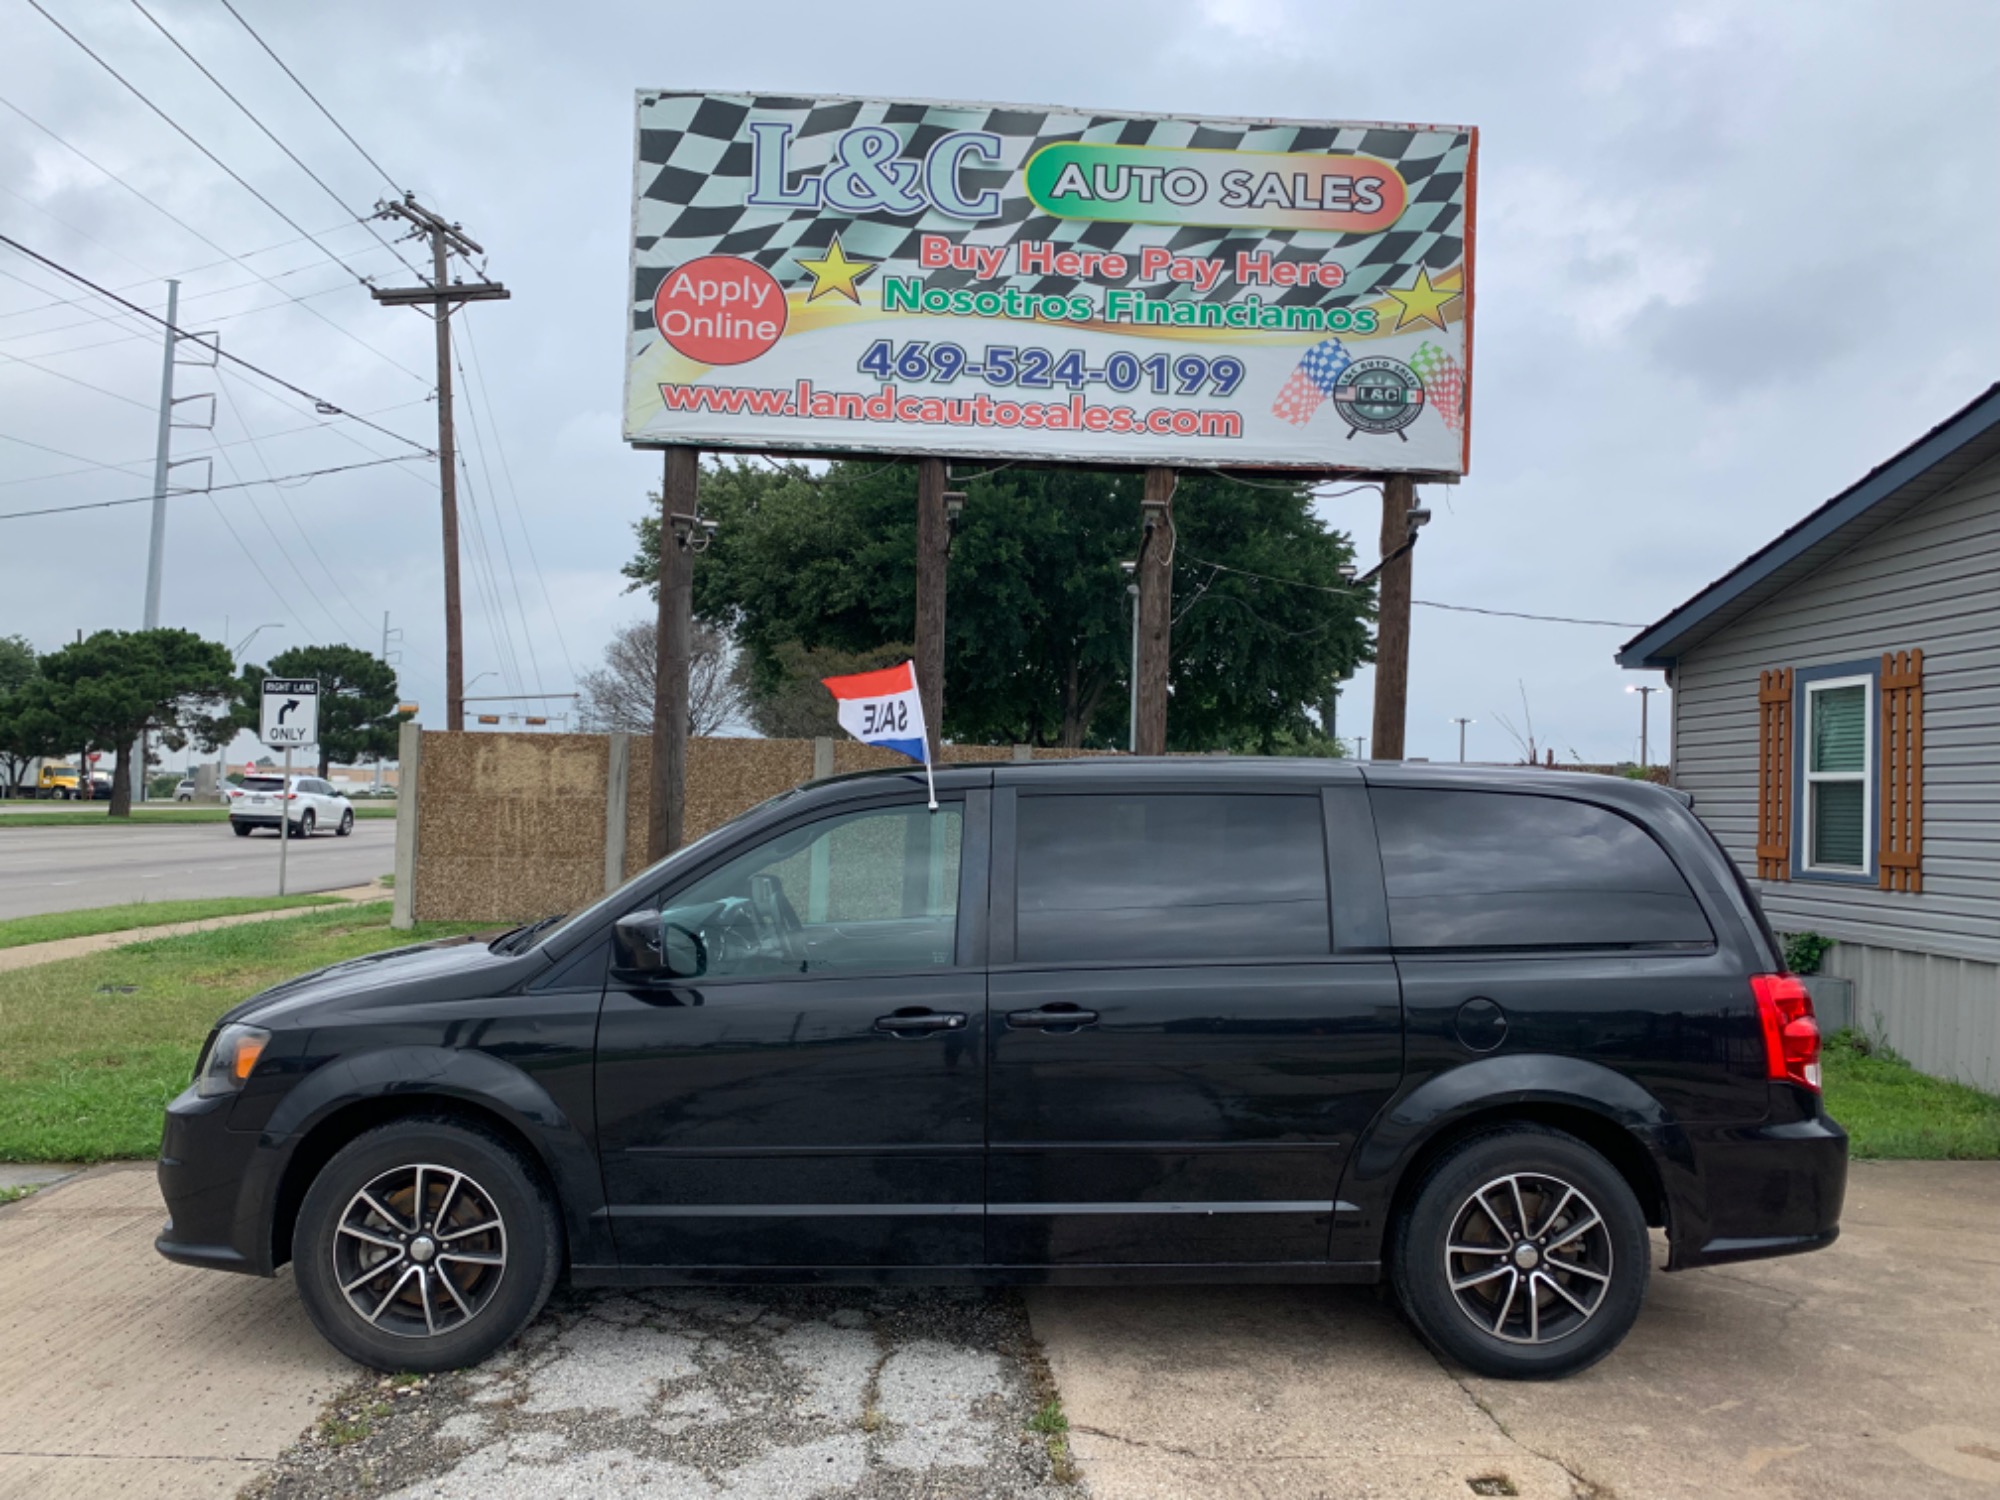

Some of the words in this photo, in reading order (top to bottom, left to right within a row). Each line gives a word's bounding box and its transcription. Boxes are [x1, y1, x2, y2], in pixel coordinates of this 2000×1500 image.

[747, 122, 1002, 217] L&C
[1050, 163, 1207, 206] AUTO
[1219, 170, 1384, 213] SALES
[920, 235, 1008, 279] Buy
[1019, 241, 1126, 277] Here
[1141, 246, 1222, 291] Pay
[1236, 252, 1345, 287] Here
[669, 273, 771, 309] Apply
[883, 276, 1094, 322] Nosotros
[1105, 290, 1379, 335] Financiamos
[662, 311, 777, 341] Online
[858, 339, 1245, 396] 469-524-0199
[1360, 360, 1390, 369] AUTO
[1394, 365, 1417, 387] SALES
[658, 379, 1242, 437] www.landcautosales.com
[1360, 387, 1398, 401] L&C
[265, 681, 291, 692] RIGHT
[293, 682, 316, 693] LANE
[270, 727, 307, 741] ONLY
